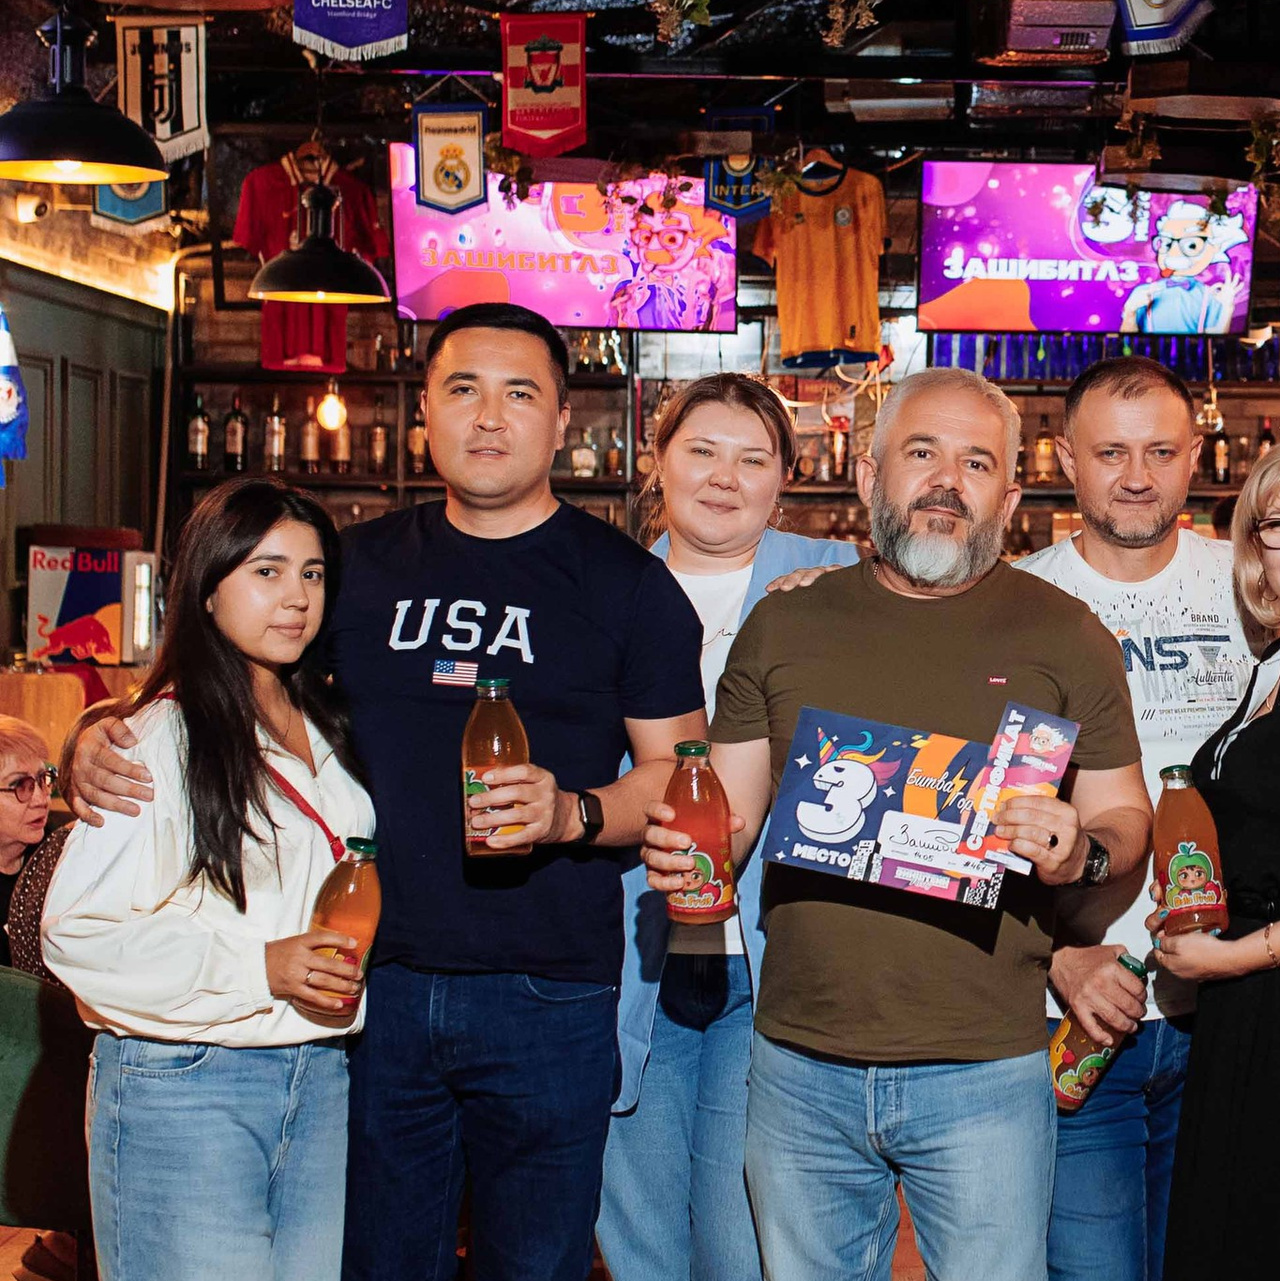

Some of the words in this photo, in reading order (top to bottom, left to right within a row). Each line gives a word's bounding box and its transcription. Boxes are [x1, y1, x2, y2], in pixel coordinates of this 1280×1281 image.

[32, 550, 75, 571] Red
[77, 551, 119, 573] Bull
[388, 598, 534, 664] USA
[1191, 614, 1219, 623] BRAND
[906, 768, 954, 793] Битва
[796, 759, 877, 844] 3
[949, 792, 974, 813] Гор
[792, 842, 851, 867] МЕСТО
